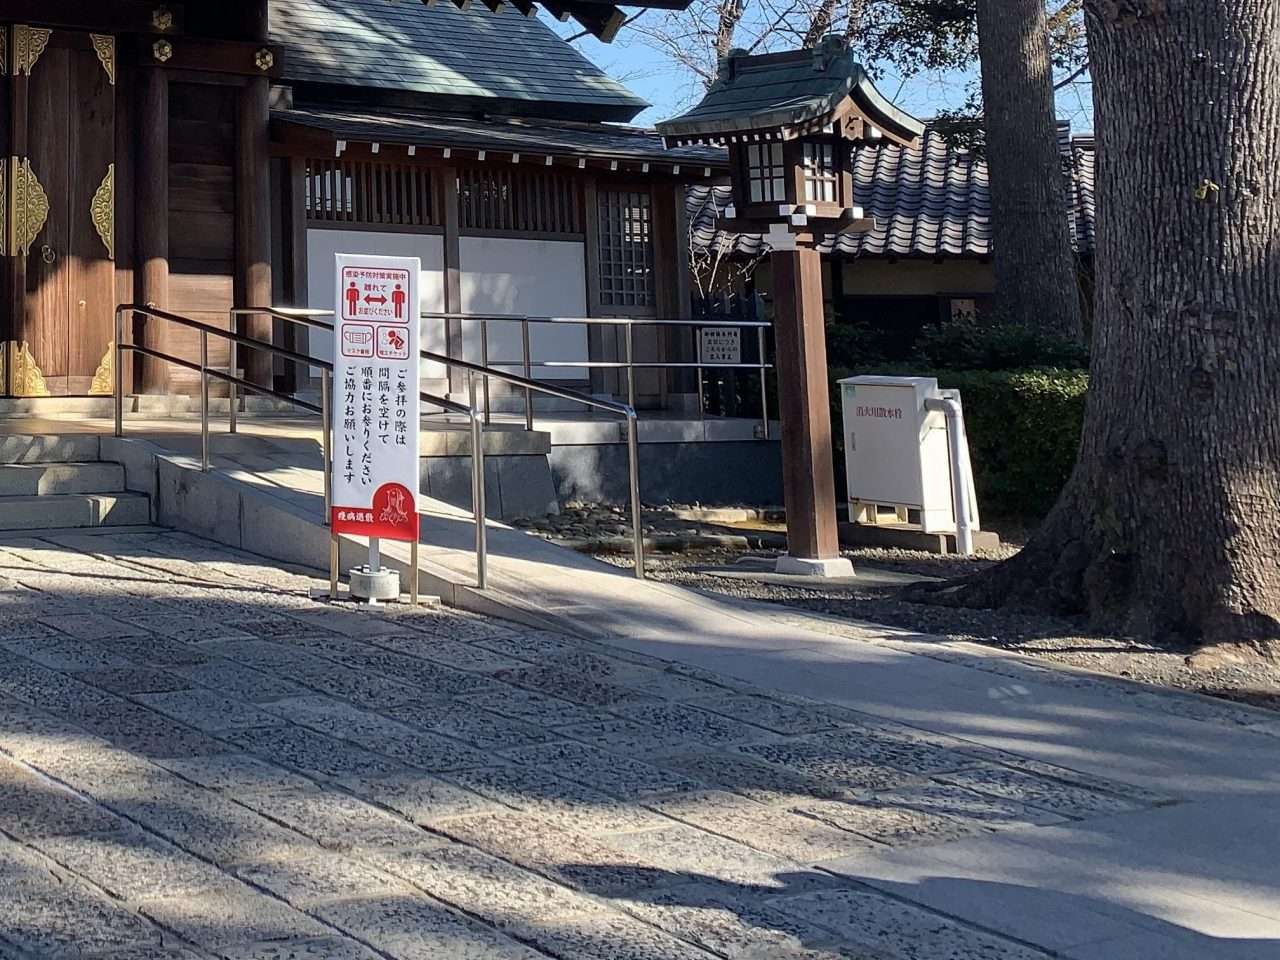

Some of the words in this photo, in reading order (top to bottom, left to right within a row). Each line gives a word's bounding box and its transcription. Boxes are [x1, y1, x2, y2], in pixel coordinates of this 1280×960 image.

[344, 365, 357, 484] ご協力お願いします
[361, 367, 373, 486] 順番にお参りください
[378, 367, 390, 444] 間隔を空けて
[394, 368, 408, 446] ご参拝の際は
